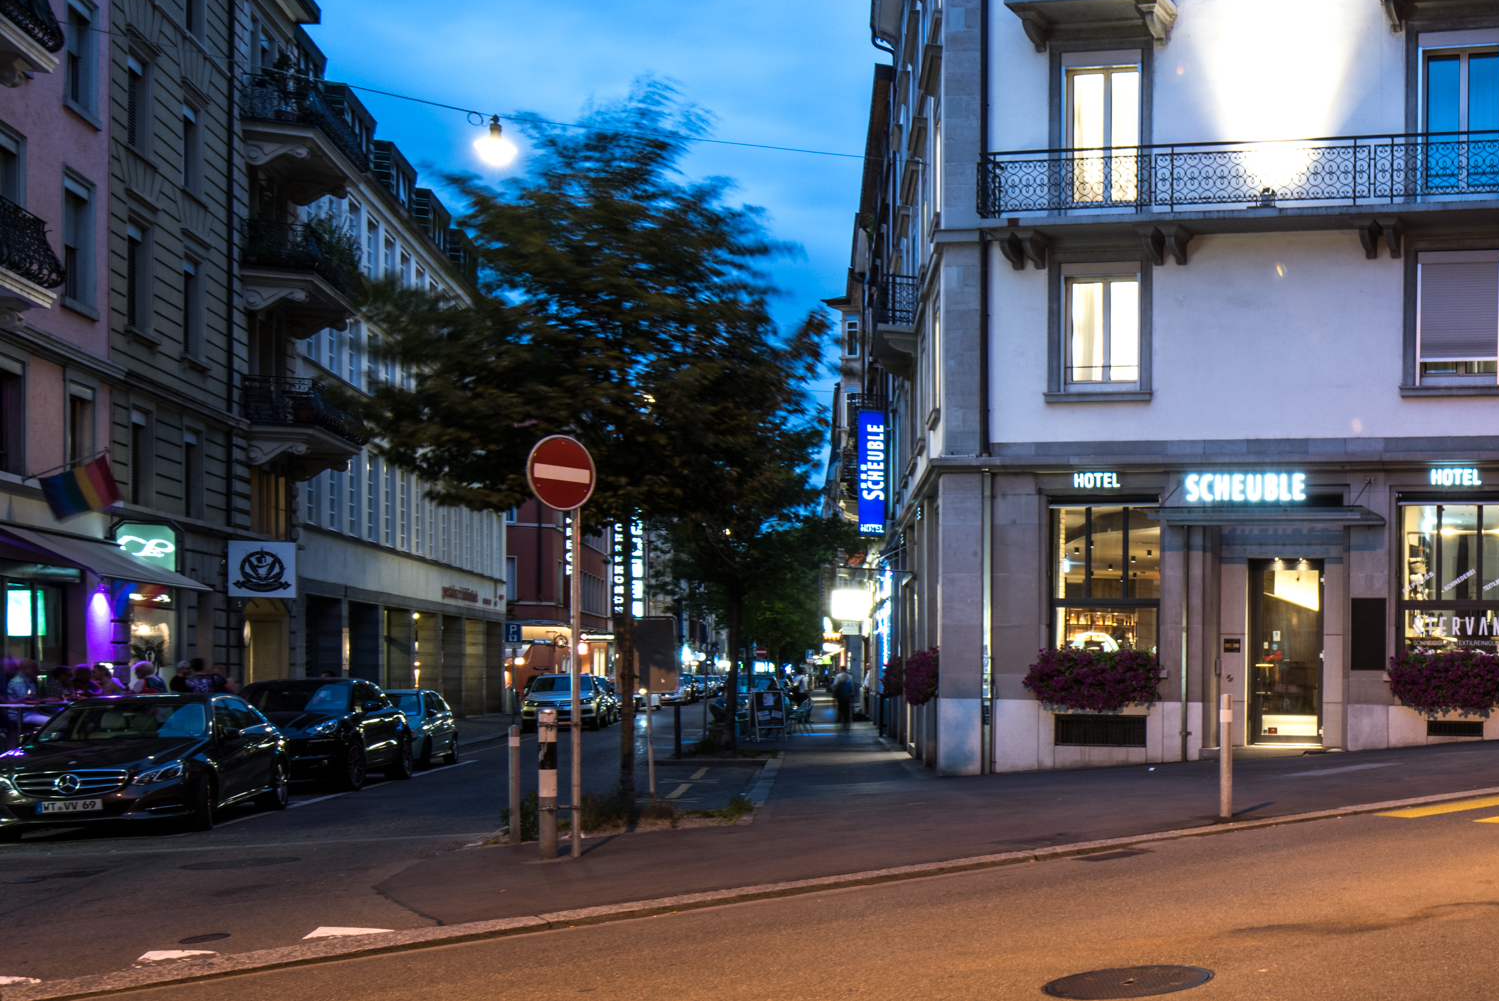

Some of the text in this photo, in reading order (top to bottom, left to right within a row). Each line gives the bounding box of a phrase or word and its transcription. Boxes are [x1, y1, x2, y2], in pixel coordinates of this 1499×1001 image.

[862, 424, 885, 500] SCHEUBLE
[1073, 472, 1121, 488] HOTEL
[1430, 467, 1482, 486] HOTEL
[1185, 473, 1307, 501] SCHEUBLE
[43, 803, 56, 811] WT
[82, 800, 96, 810] 69
